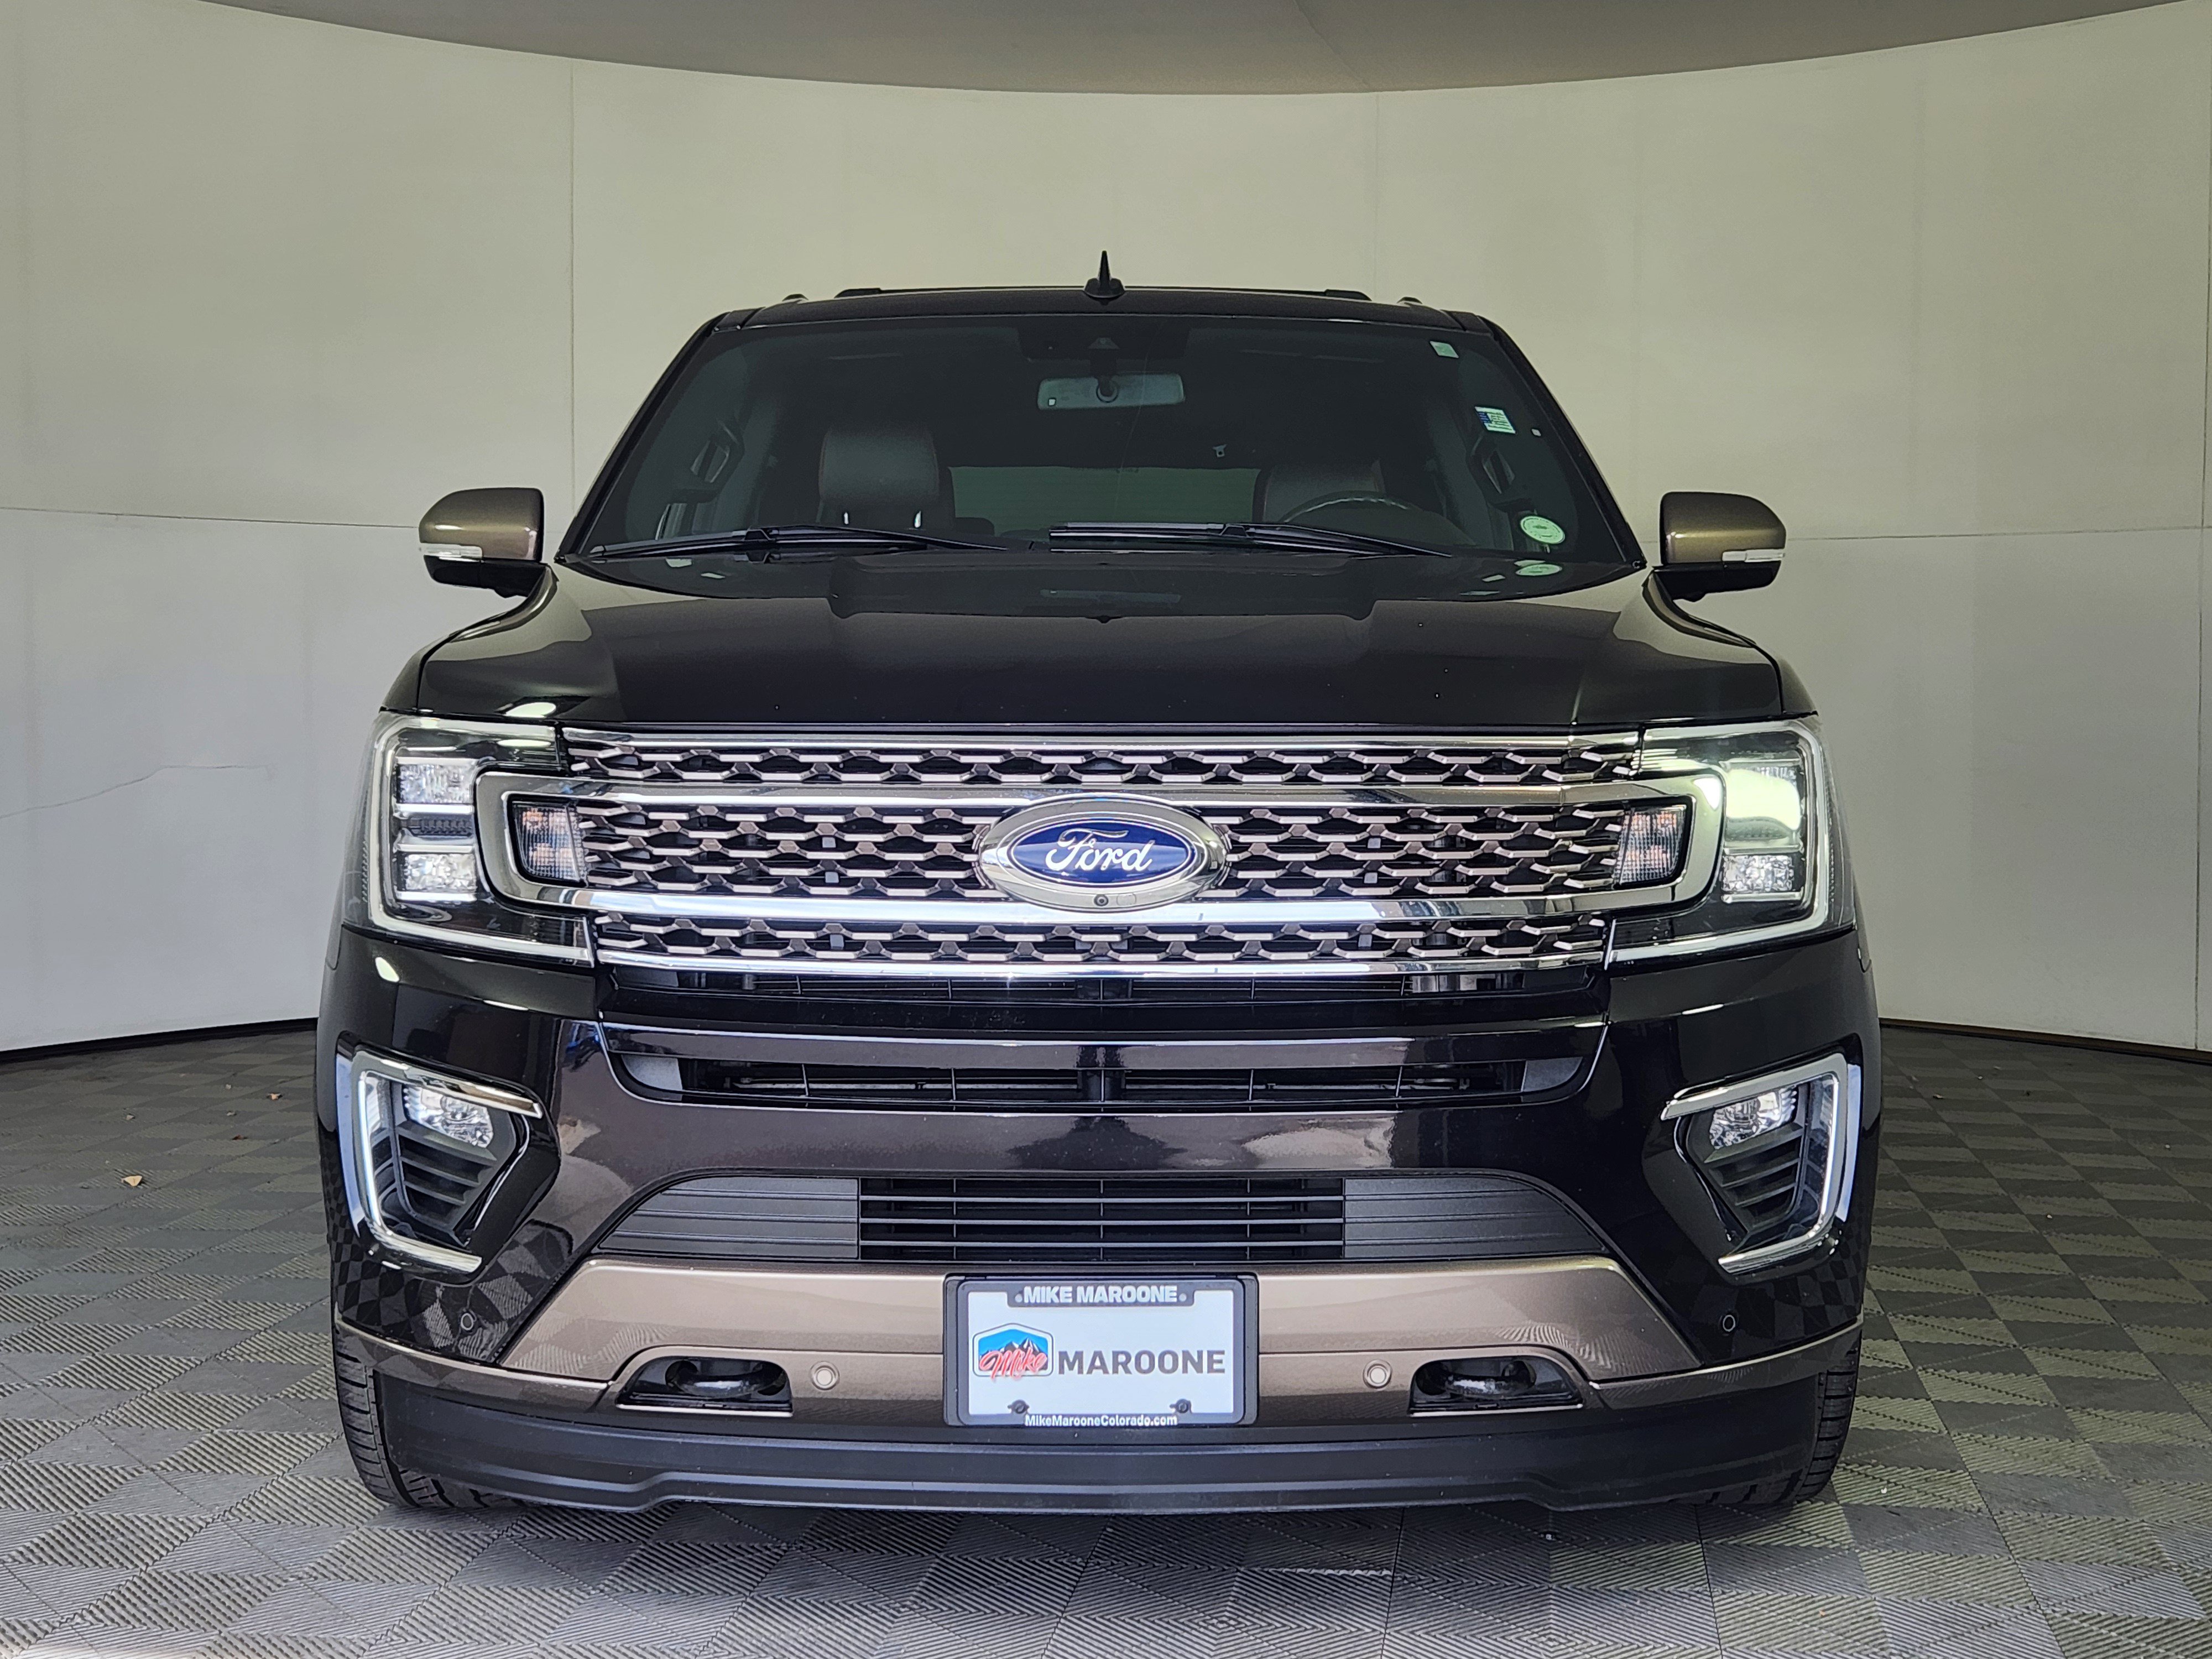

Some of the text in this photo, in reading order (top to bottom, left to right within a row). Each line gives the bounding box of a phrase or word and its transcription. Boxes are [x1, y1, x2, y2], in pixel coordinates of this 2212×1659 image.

[1046, 828, 1155, 872] Ford
[1024, 1285, 1177, 1303] MIKE MAROONE
[979, 1347, 1225, 1380] Mike MAROONE
[1025, 1414, 1177, 1426] MikeMarooneColorado.com
